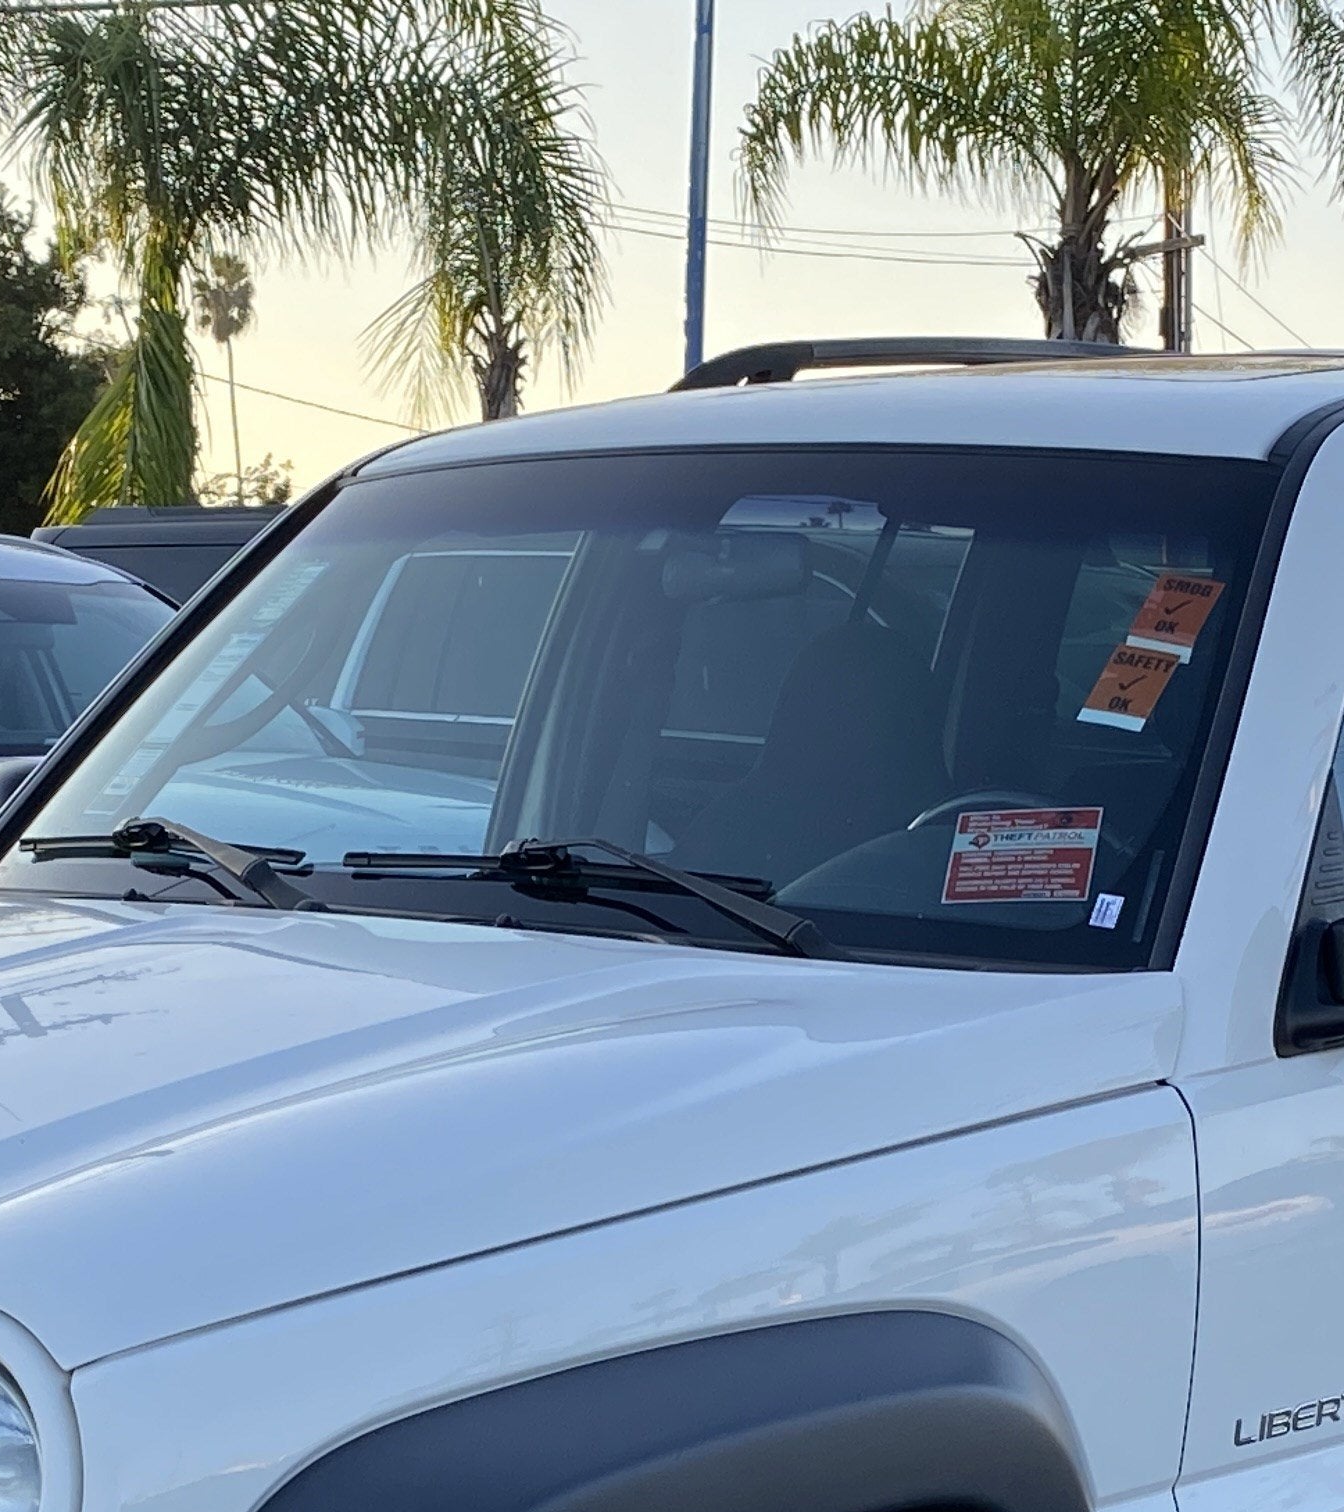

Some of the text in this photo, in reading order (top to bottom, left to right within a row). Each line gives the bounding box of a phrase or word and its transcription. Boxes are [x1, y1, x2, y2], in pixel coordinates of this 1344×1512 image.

[1164, 579, 1214, 597] SMOG
[1154, 619, 1179, 634] OK
[1113, 651, 1176, 673] SAFETY
[1108, 696, 1133, 711] OK
